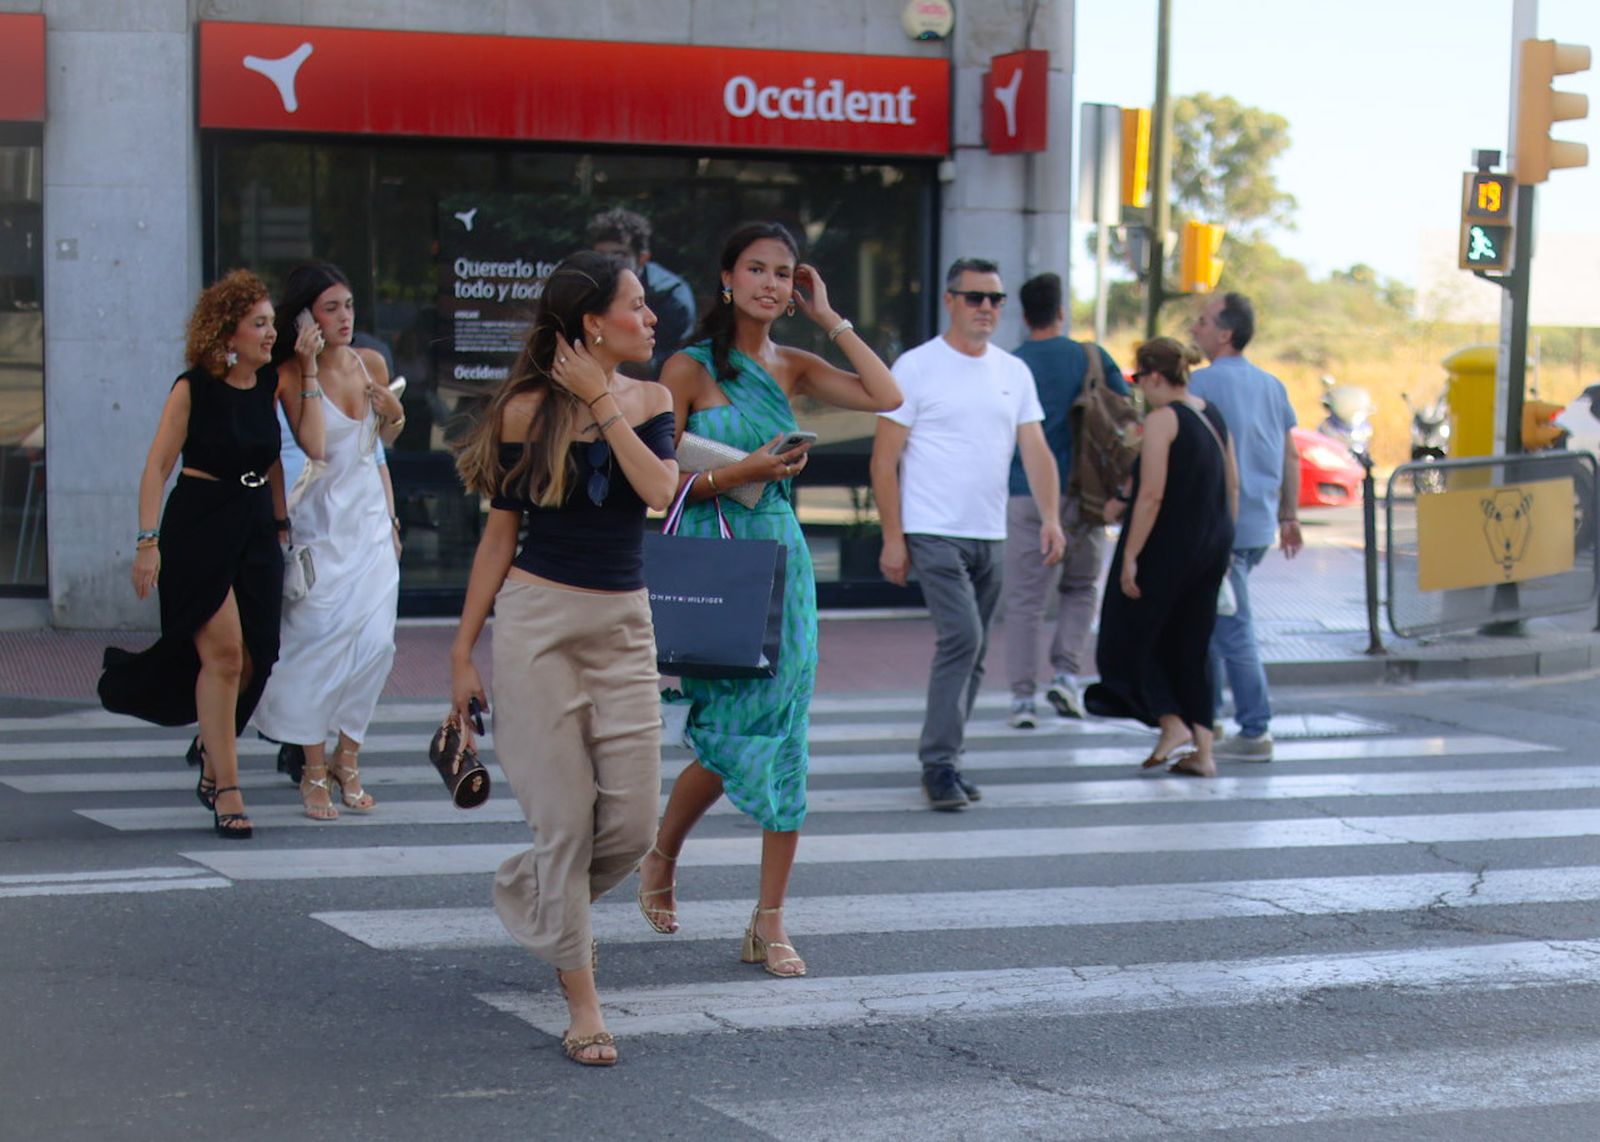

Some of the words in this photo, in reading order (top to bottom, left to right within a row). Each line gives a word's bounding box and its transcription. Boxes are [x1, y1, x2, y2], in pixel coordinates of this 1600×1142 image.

[723, 75, 916, 125] Occident
[1478, 181, 1502, 212] 19
[454, 258, 534, 279] Quererlo
[454, 279, 495, 299] todo
[498, 283, 509, 302] y
[650, 594, 677, 602] OMMY
